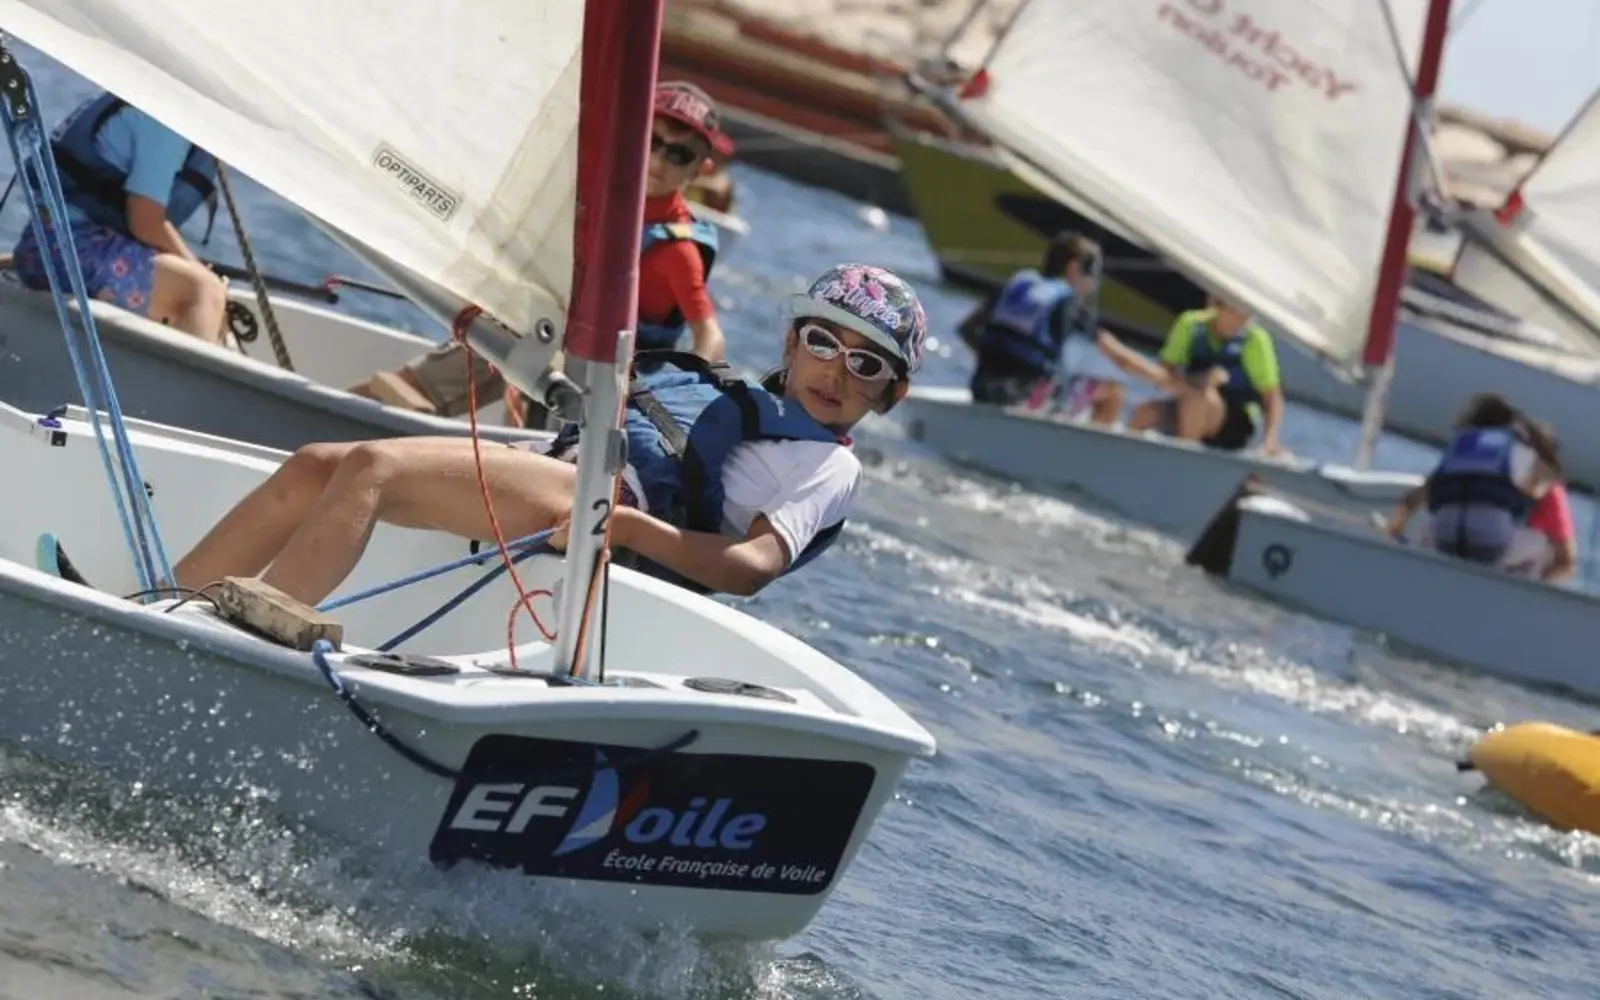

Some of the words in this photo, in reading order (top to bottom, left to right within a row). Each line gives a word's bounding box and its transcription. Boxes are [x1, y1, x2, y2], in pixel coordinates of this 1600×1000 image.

[377, 155, 452, 212] OPTIPARTS
[602, 849, 656, 871] École
[657, 856, 750, 879] Française
[751, 863, 776, 879] de
[780, 866, 827, 883] Voile
